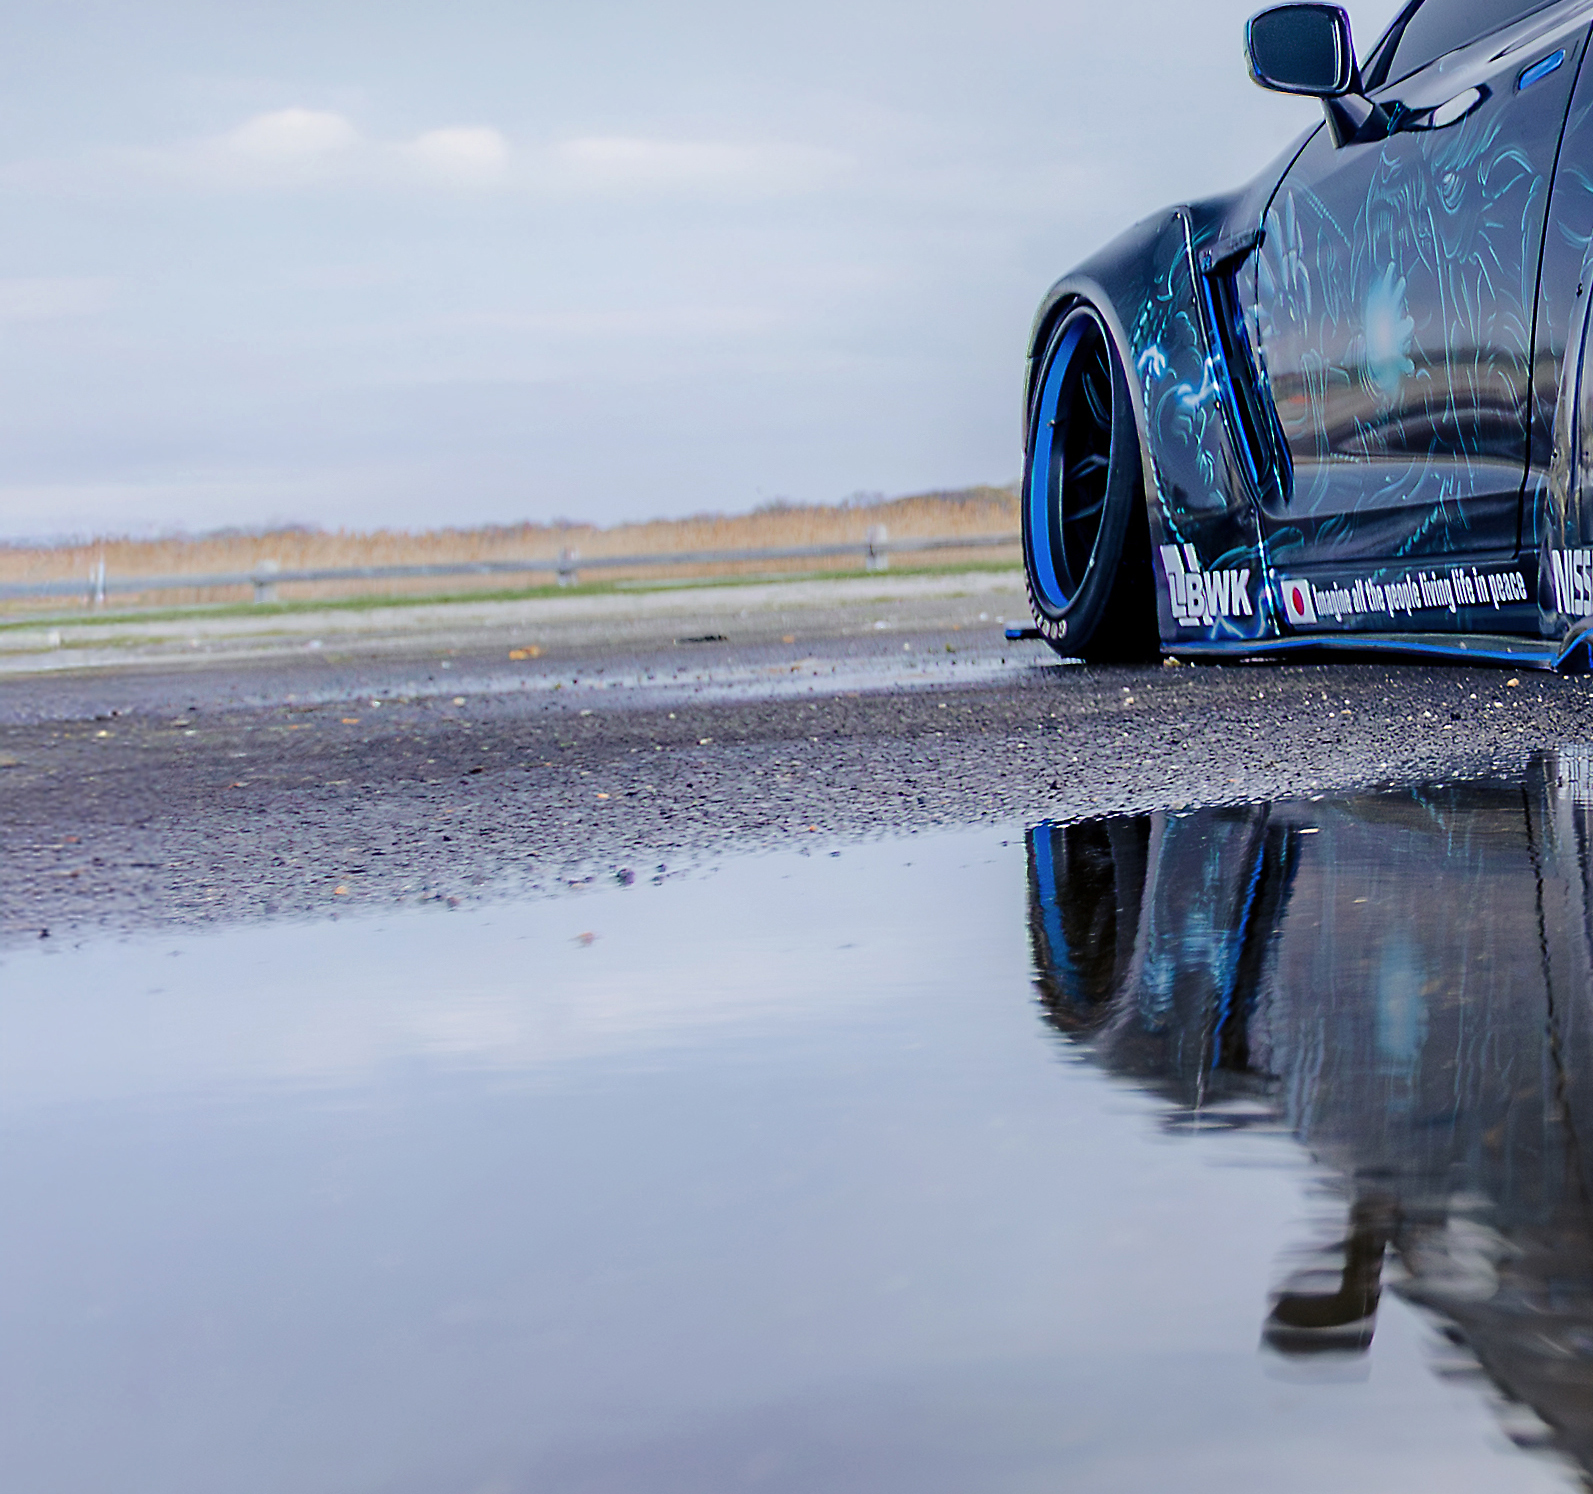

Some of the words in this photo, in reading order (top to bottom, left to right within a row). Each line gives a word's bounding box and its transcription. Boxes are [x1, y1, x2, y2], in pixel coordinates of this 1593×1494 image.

[1312, 582, 1353, 623] Imagine
[1352, 579, 1368, 613] all
[1365, 578, 1386, 612] the
[1384, 573, 1421, 618] people
[1419, 571, 1456, 613] living
[1451, 568, 1476, 604] life
[1472, 566, 1490, 603] in
[1488, 571, 1527, 610] peace
